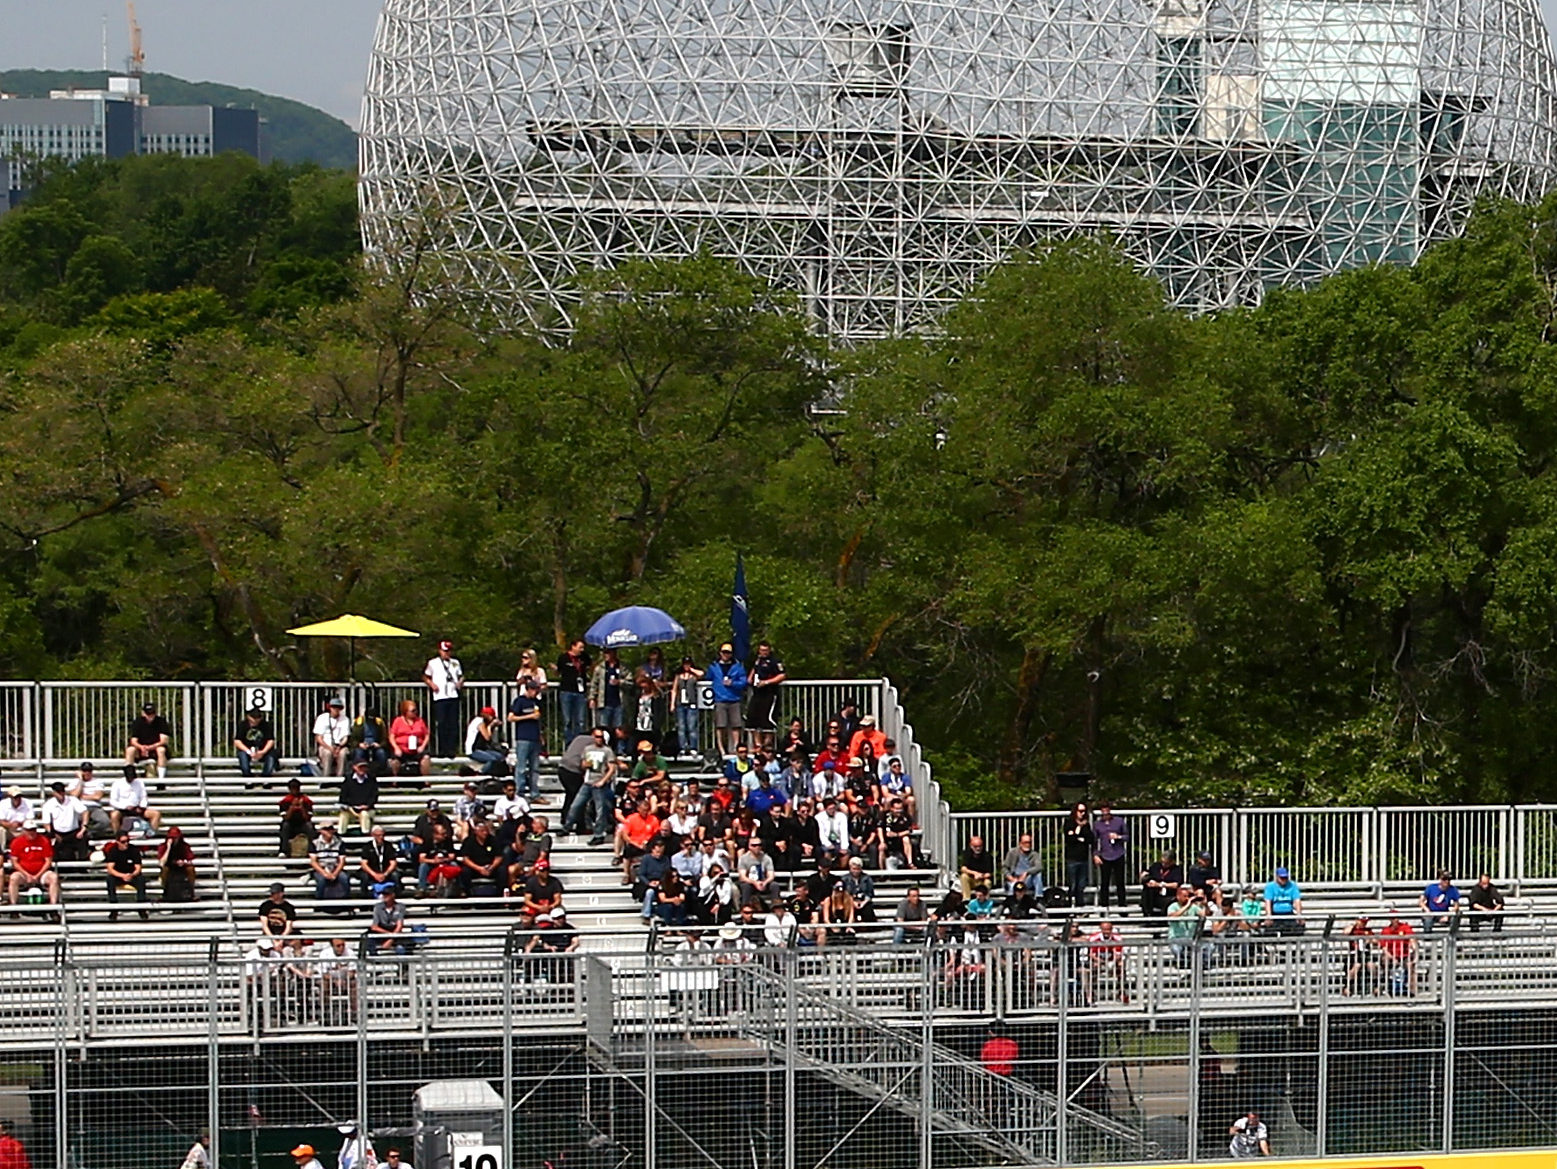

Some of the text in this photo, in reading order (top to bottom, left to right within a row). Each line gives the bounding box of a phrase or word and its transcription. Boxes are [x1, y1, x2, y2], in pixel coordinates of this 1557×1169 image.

[252, 688, 266, 708] 8
[702, 687, 715, 706] 9
[1156, 815, 1169, 835] 9
